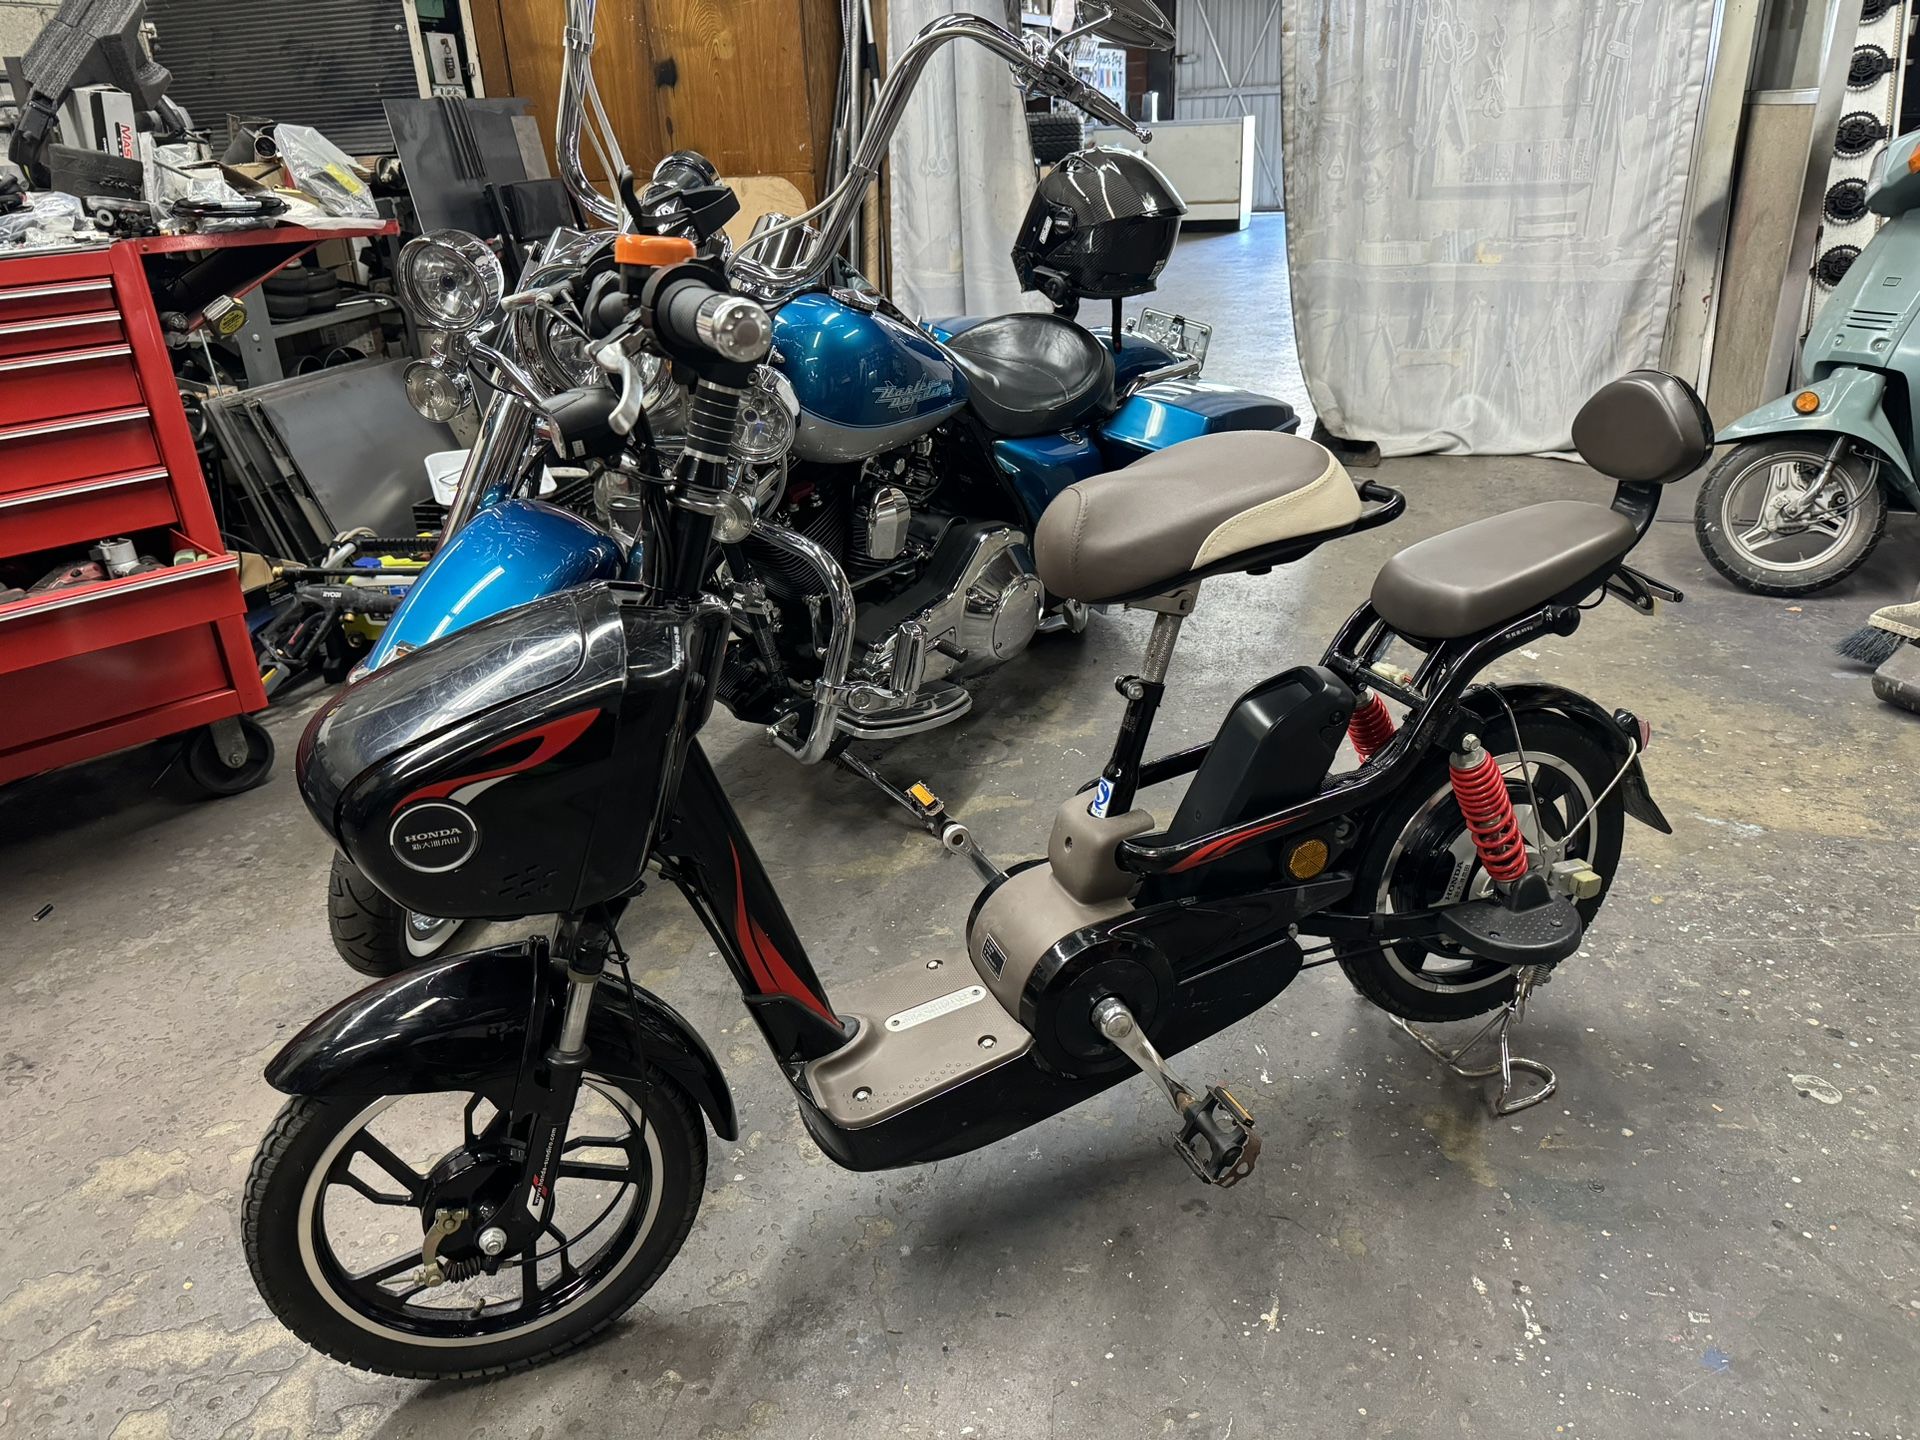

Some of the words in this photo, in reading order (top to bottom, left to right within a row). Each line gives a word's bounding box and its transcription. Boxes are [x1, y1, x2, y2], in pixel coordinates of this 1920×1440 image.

[322, 591, 342, 599] RYOBI
[404, 827, 463, 843] HONDA
[1445, 861, 1464, 900] HONDA
[533, 1127, 557, 1205] www.honda-sundiro.com
